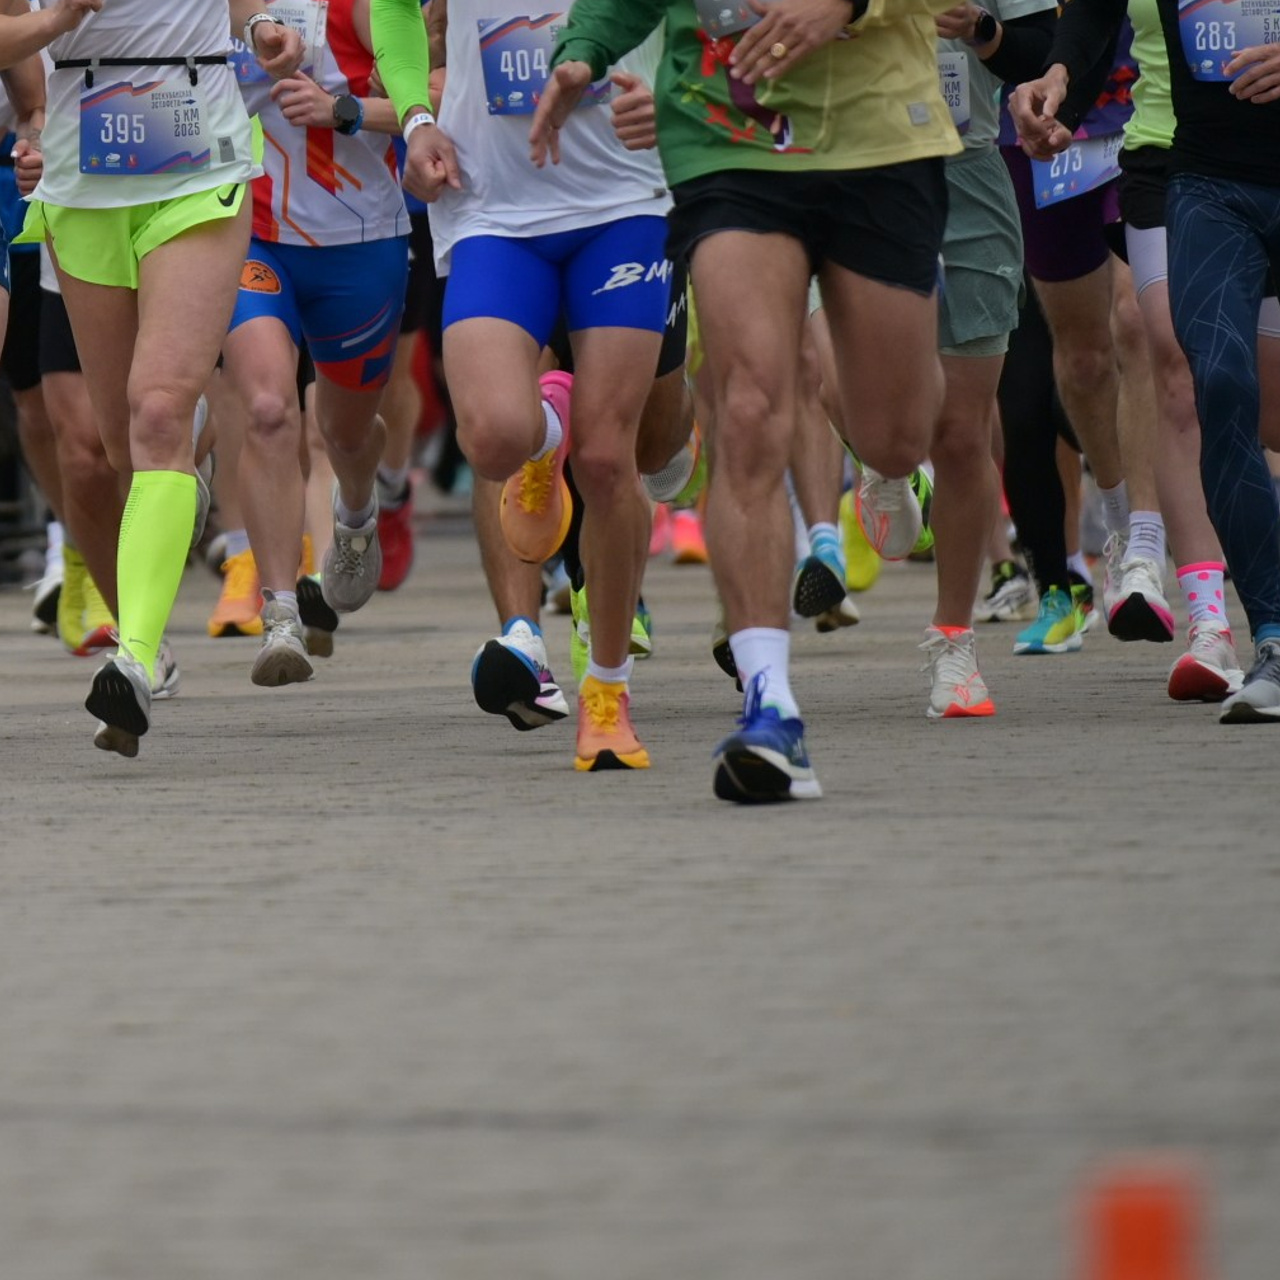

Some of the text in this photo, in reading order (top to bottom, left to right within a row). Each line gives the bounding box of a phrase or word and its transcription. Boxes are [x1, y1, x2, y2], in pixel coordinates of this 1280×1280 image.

[1264, 18, 1270, 30] 5
[1195, 22, 1235, 50] 283
[500, 48, 548, 81] 404
[174, 110, 180, 122] 5
[100, 114, 145, 144] 395
[174, 122, 200, 137] 2025
